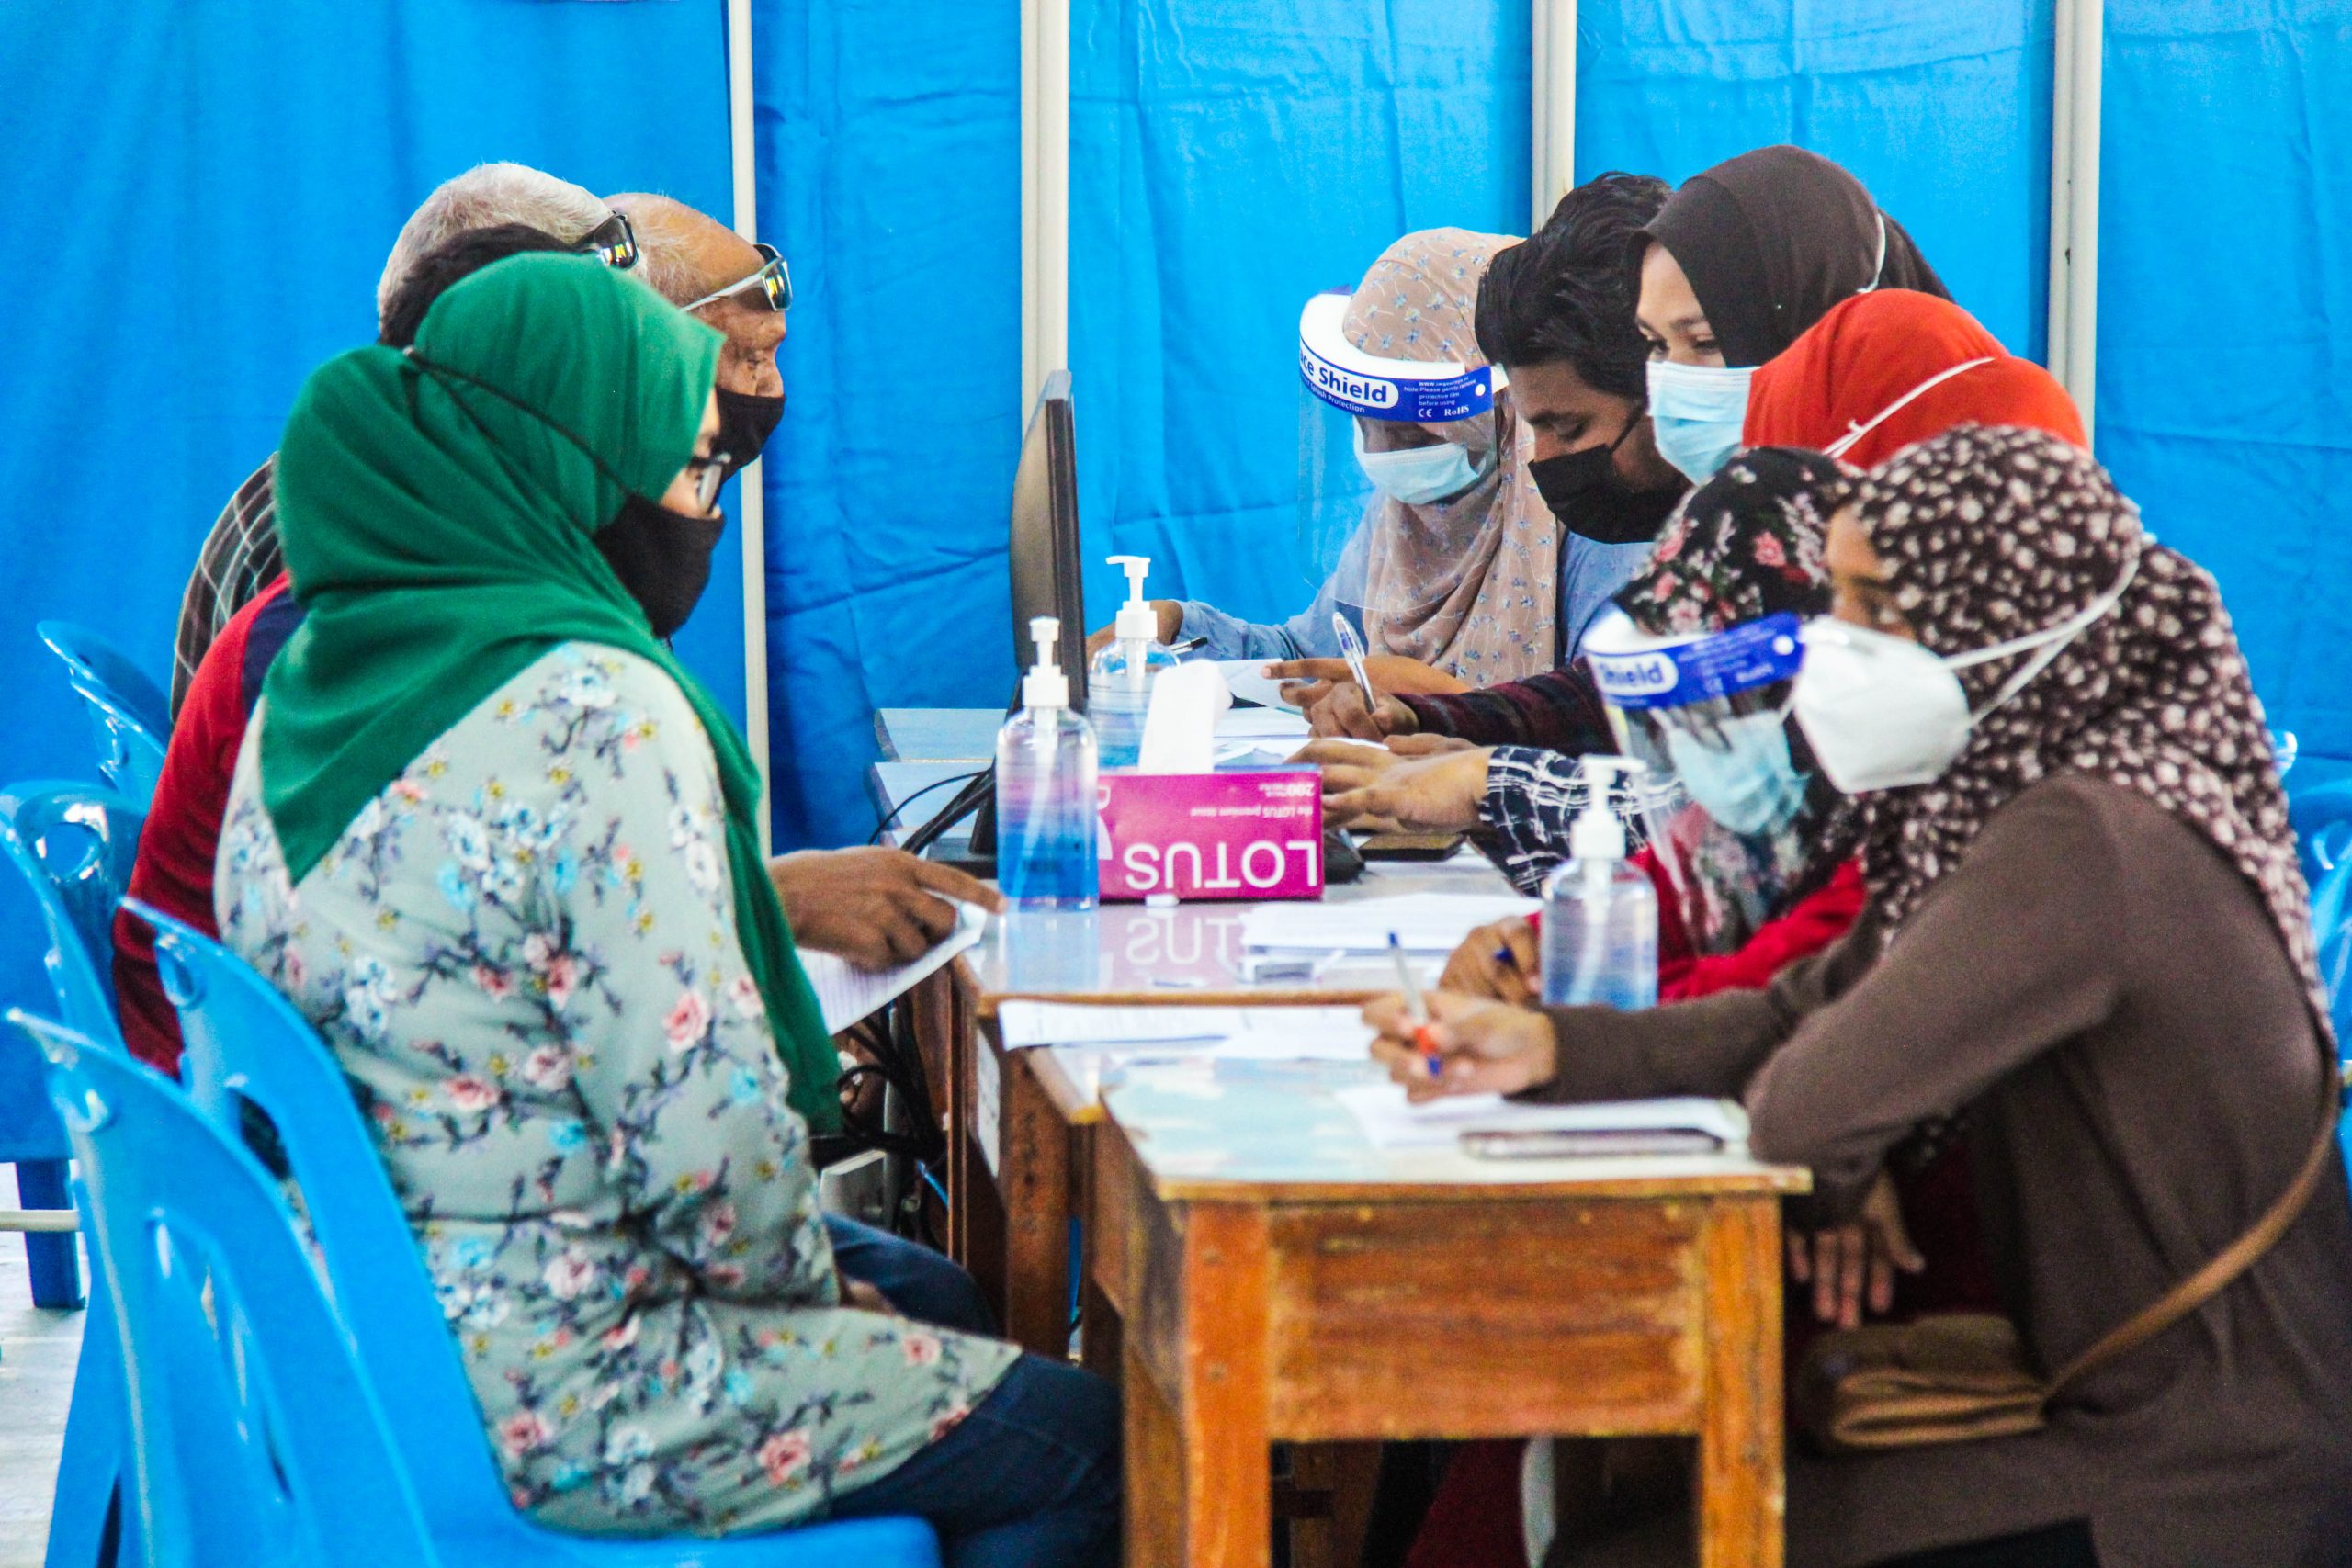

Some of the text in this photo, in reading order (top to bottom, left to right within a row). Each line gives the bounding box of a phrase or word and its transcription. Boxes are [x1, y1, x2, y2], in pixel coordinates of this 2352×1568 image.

[1300, 349, 1387, 402] ace Shield
[1328, 394, 1365, 413] Protection
[1444, 405, 1470, 417] RoHS
[1262, 805, 1295, 818] LOTUS
[1122, 840, 1318, 890] LOTUS
